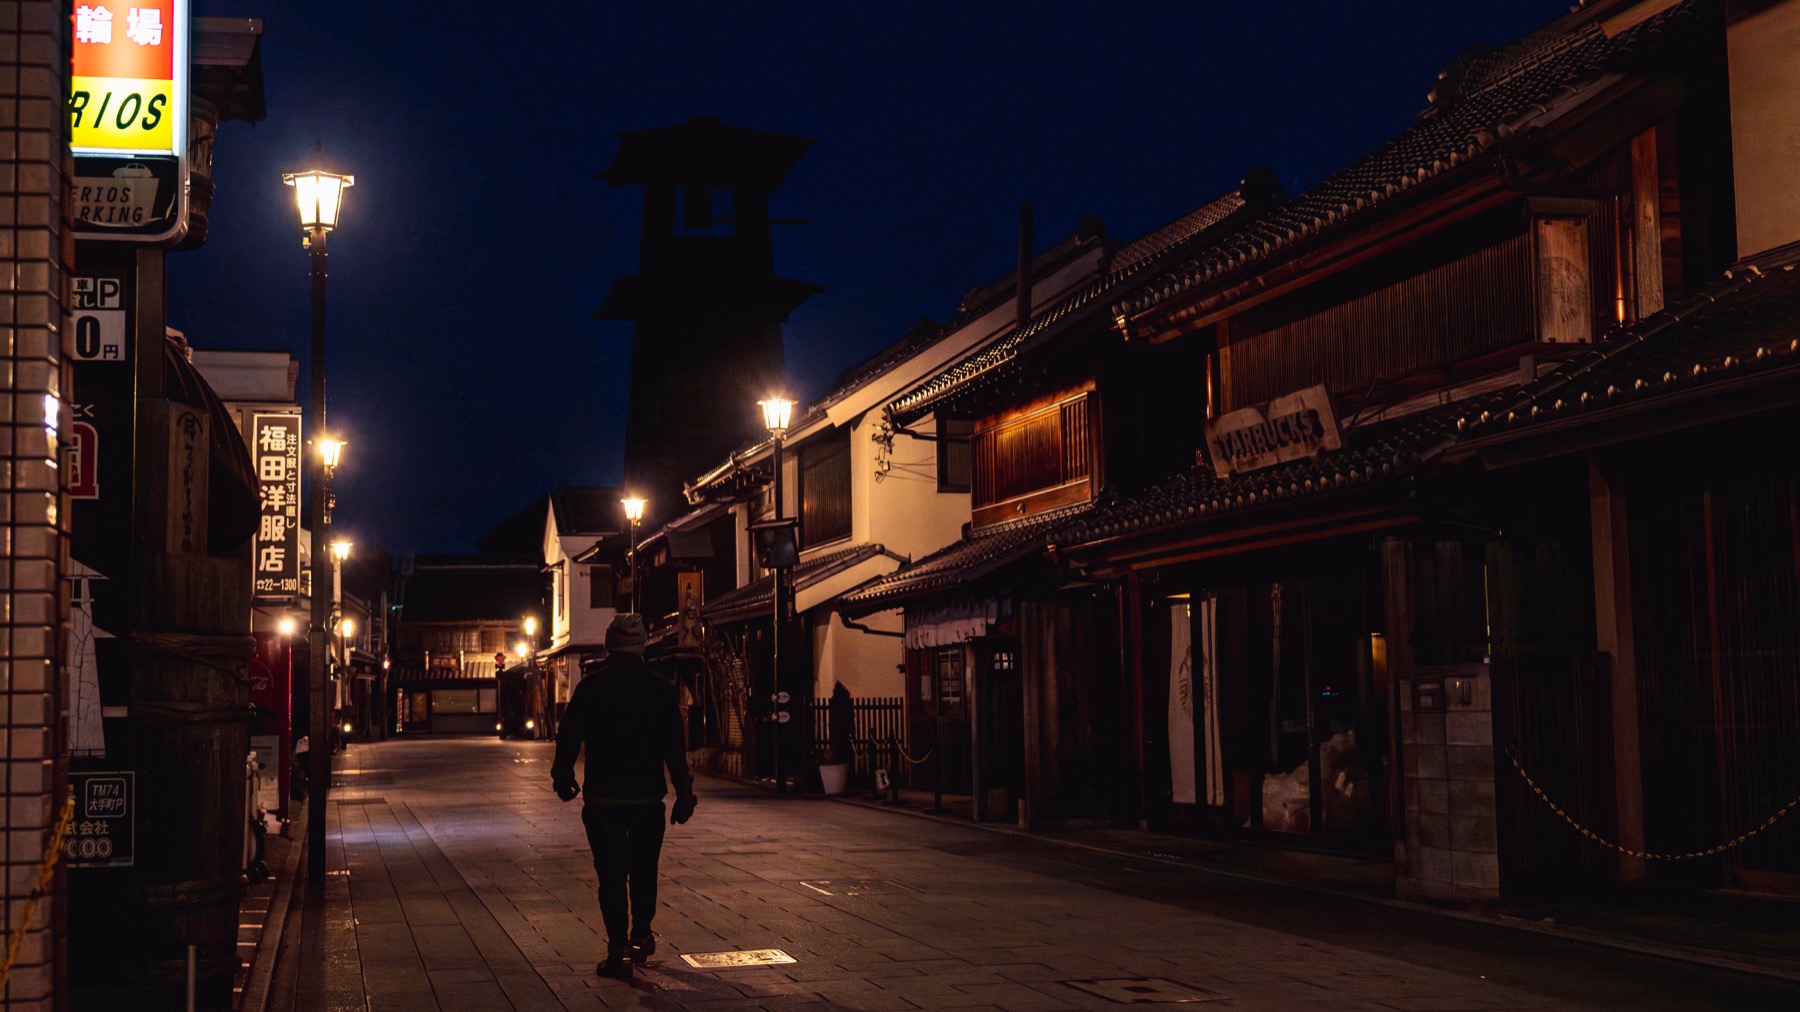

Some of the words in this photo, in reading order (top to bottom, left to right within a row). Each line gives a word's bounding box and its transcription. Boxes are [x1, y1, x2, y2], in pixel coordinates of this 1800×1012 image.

[77, 5, 163, 46] 輪場
[72, 90, 167, 130] RIOS
[100, 280, 119, 306] P
[259, 425, 287, 572] 福田洋服店
[285, 433, 297, 529] 注文服と寸法直し
[88, 797, 123, 811] 大手町P
[92, 784, 119, 796] TM74
